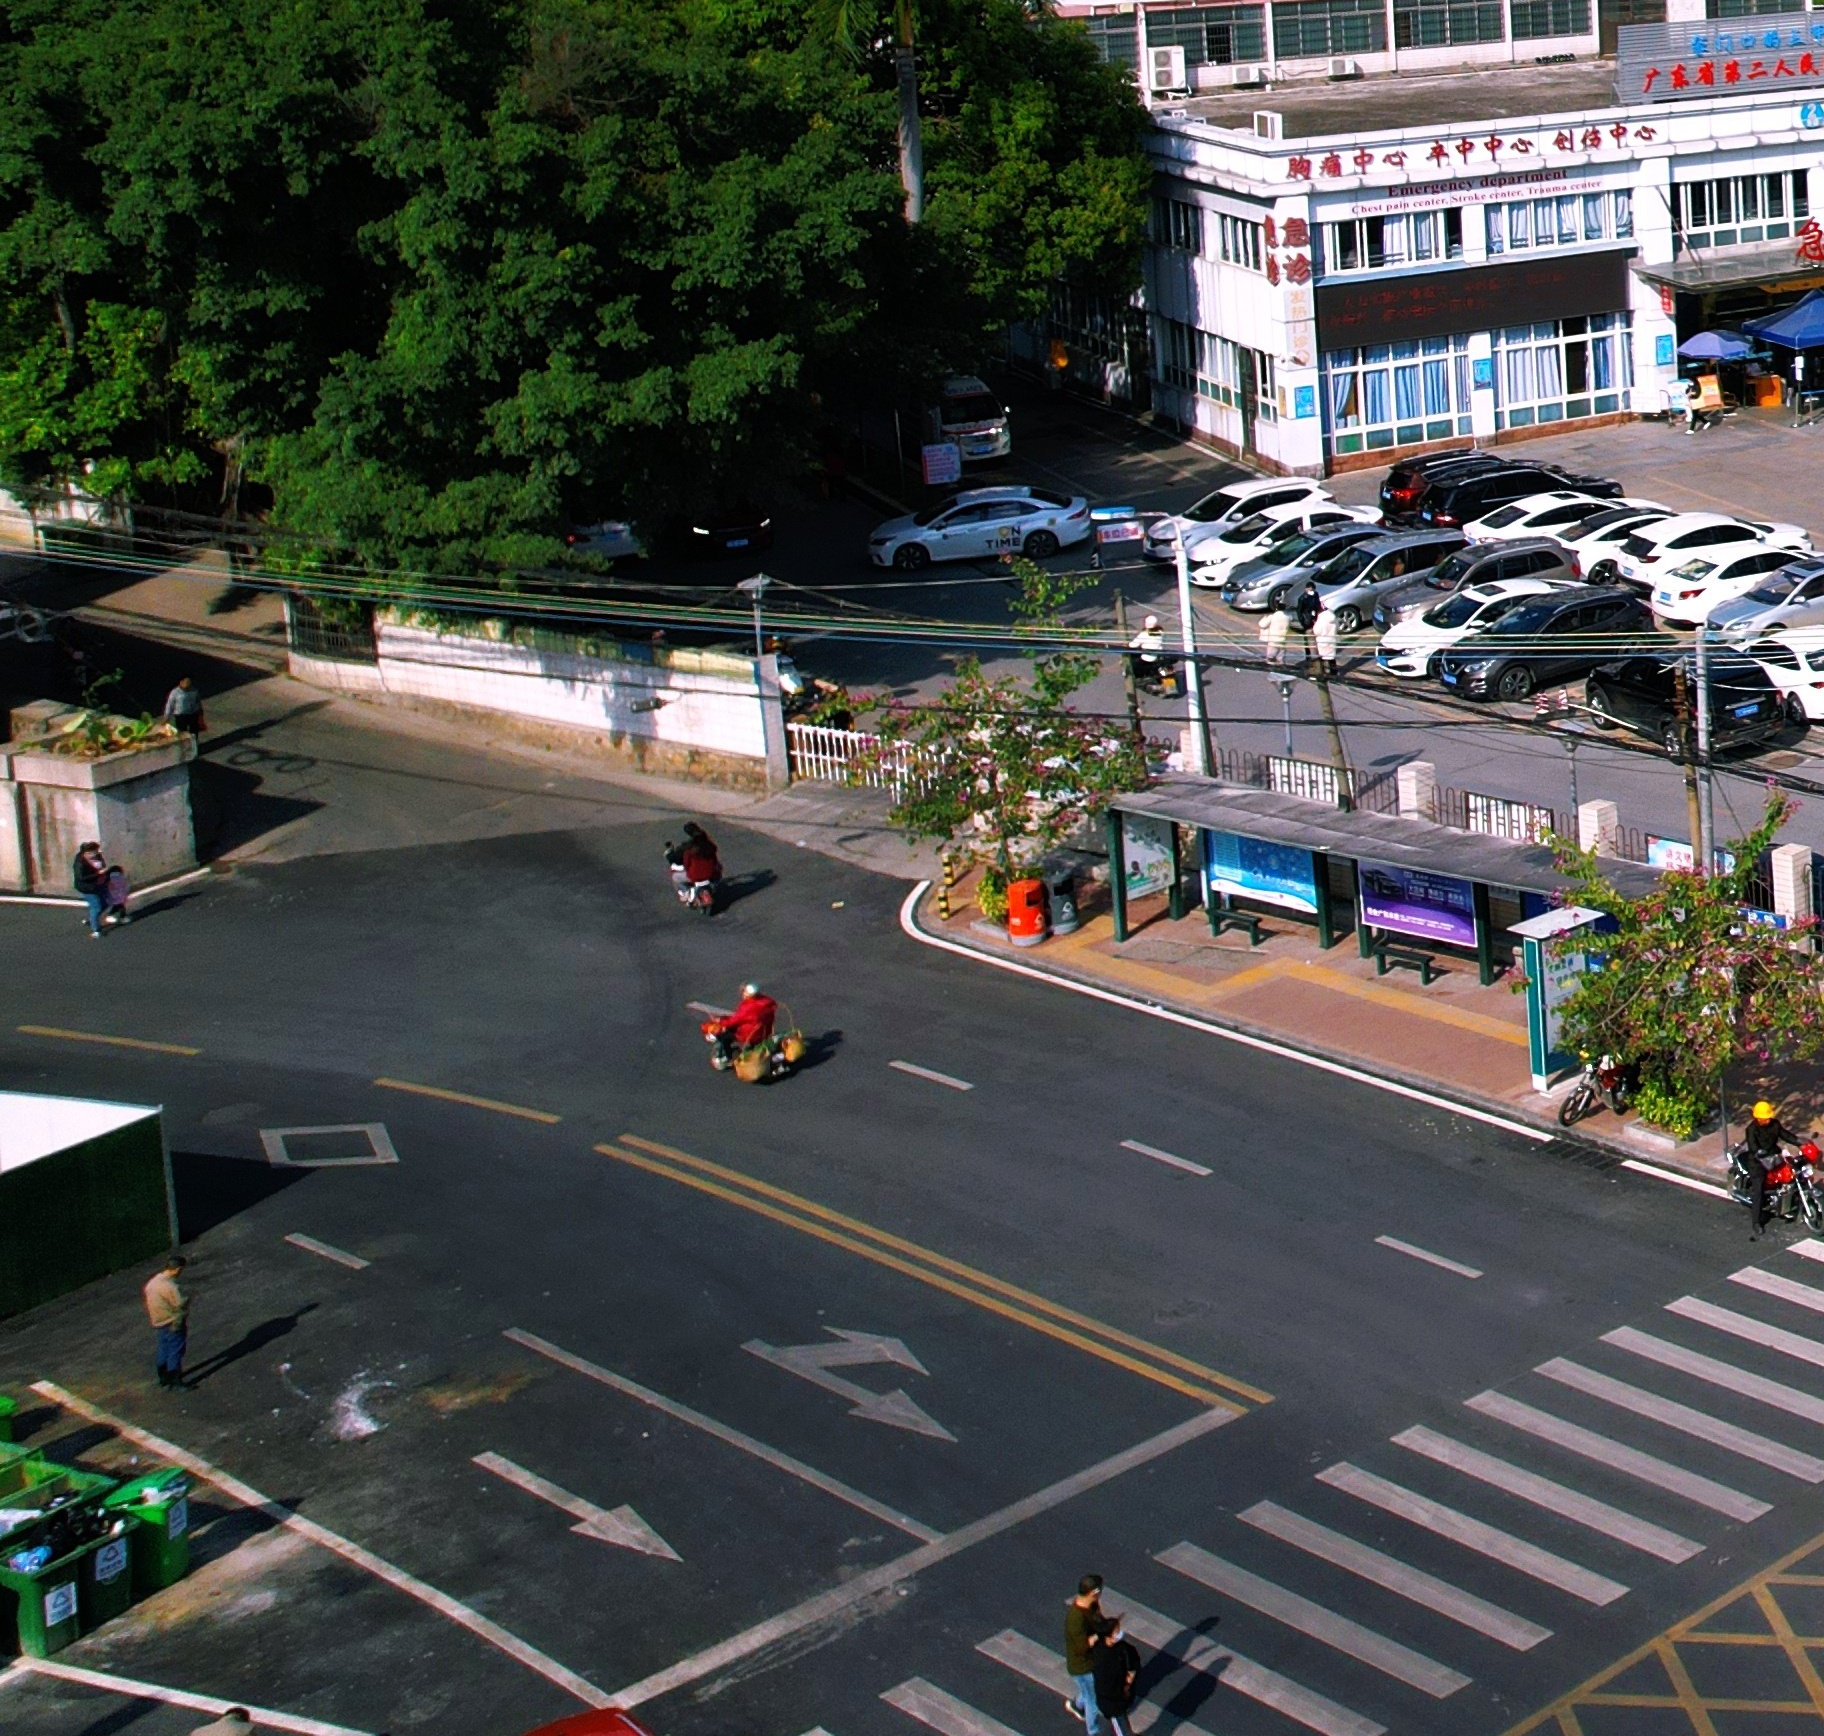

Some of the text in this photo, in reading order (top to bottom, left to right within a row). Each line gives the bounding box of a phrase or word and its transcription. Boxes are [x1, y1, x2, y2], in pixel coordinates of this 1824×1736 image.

[1288, 121, 1658, 181] 胸痛中心 卒中中心 创伤中心
[1387, 168, 1568, 198] Emergency department
[1351, 203, 1383, 215] Chest
[1386, 200, 1410, 211] pain
[1282, 216, 1312, 285] 急诊
[984, 538, 1021, 550] TIME
